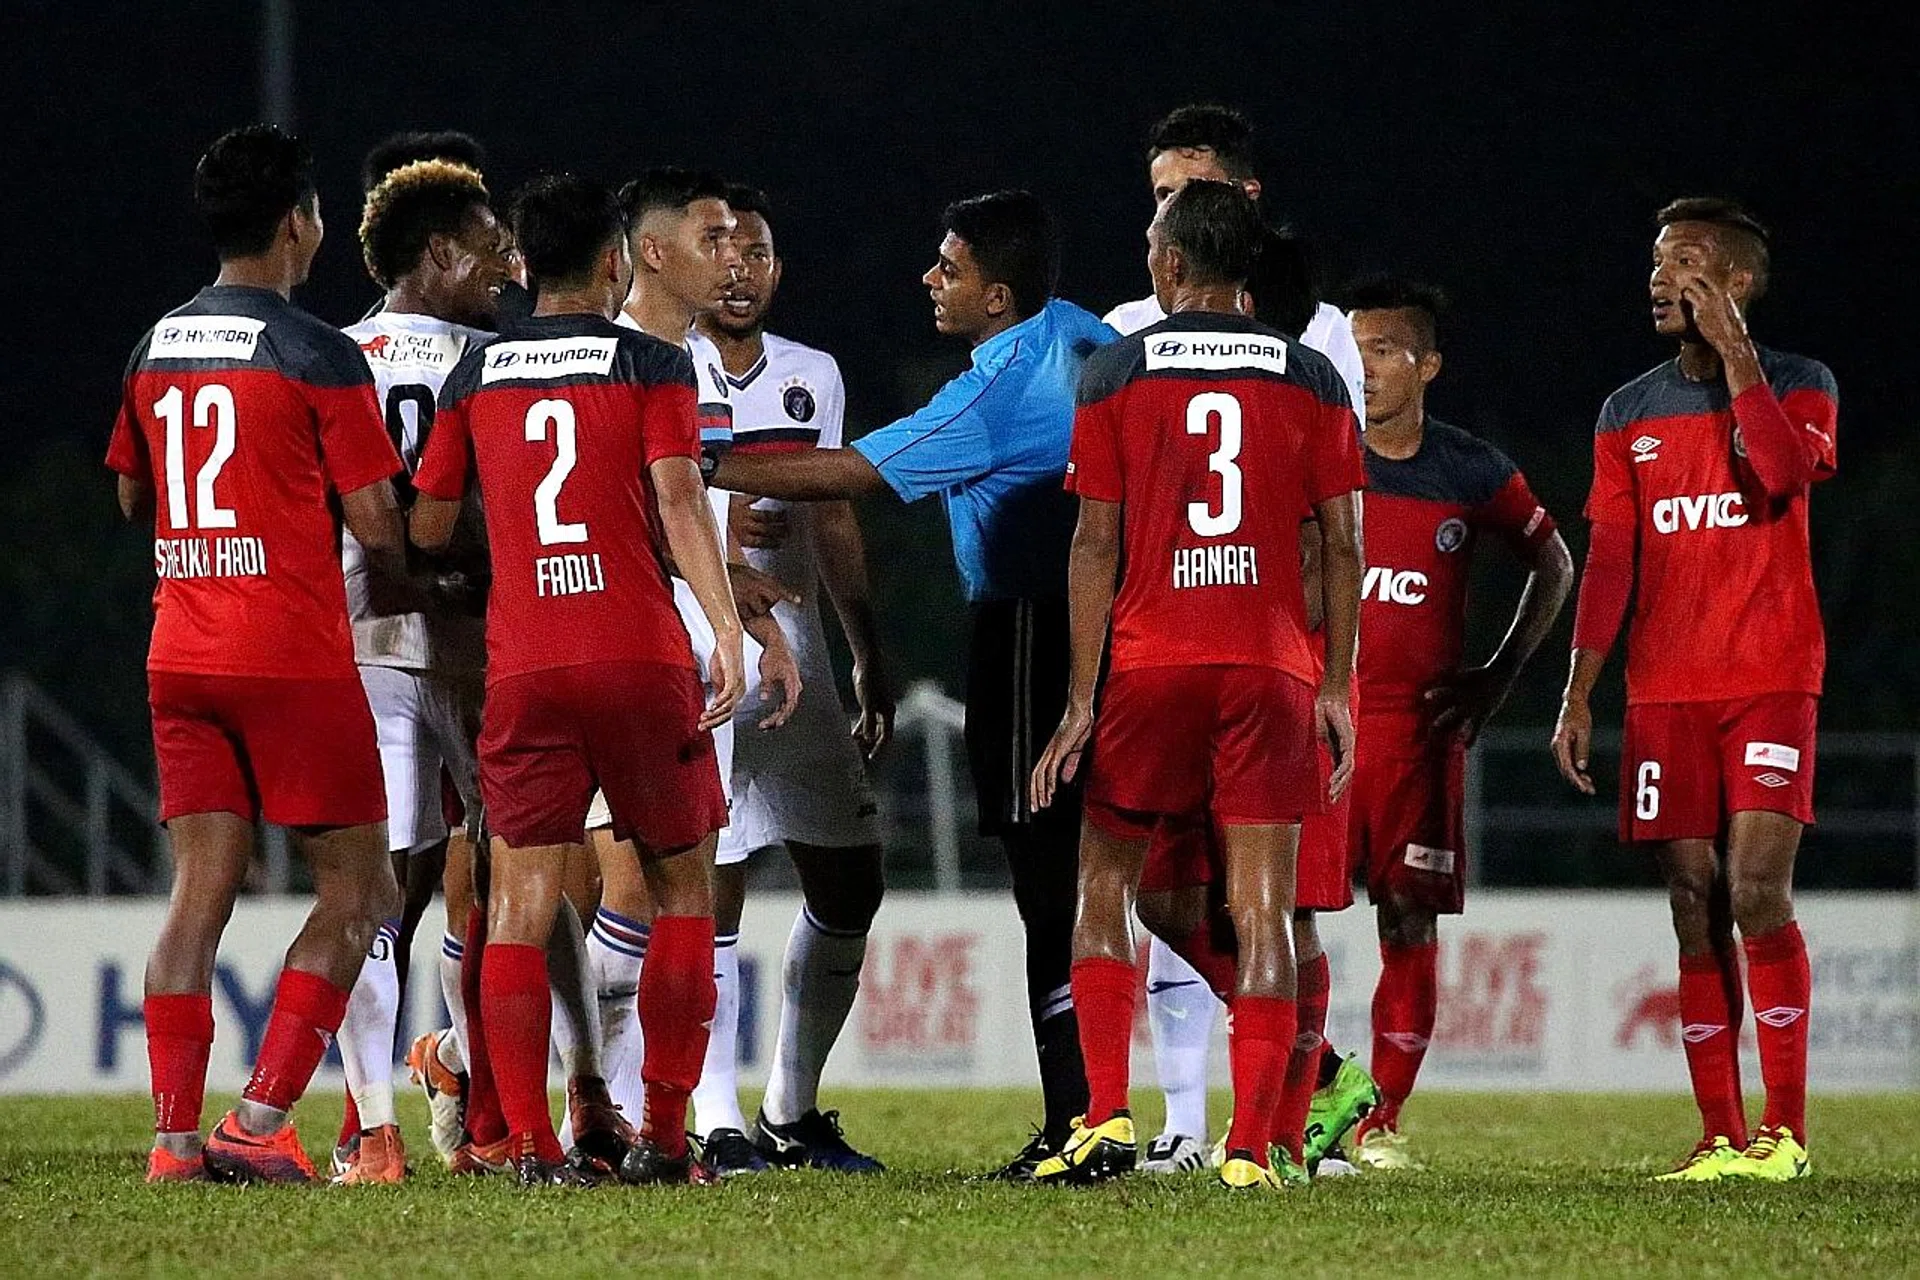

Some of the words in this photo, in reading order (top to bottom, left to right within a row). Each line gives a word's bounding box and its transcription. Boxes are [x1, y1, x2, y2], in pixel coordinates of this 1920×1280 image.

[186, 329, 253, 345] HYUNDAI
[525, 348, 609, 365] HYUNDAI
[1192, 343, 1281, 361] HYUNDAI
[153, 383, 237, 529] 12
[525, 398, 589, 546] 2
[1186, 392, 1243, 537] 3
[1653, 492, 1749, 534] CIVIC
[155, 537, 211, 579] SHEIKH
[216, 537, 266, 577] HADI
[536, 553, 605, 597] FADLI
[1173, 545, 1259, 589] HANAFI
[1361, 567, 1428, 605] VIC
[1636, 761, 1661, 821] 6
